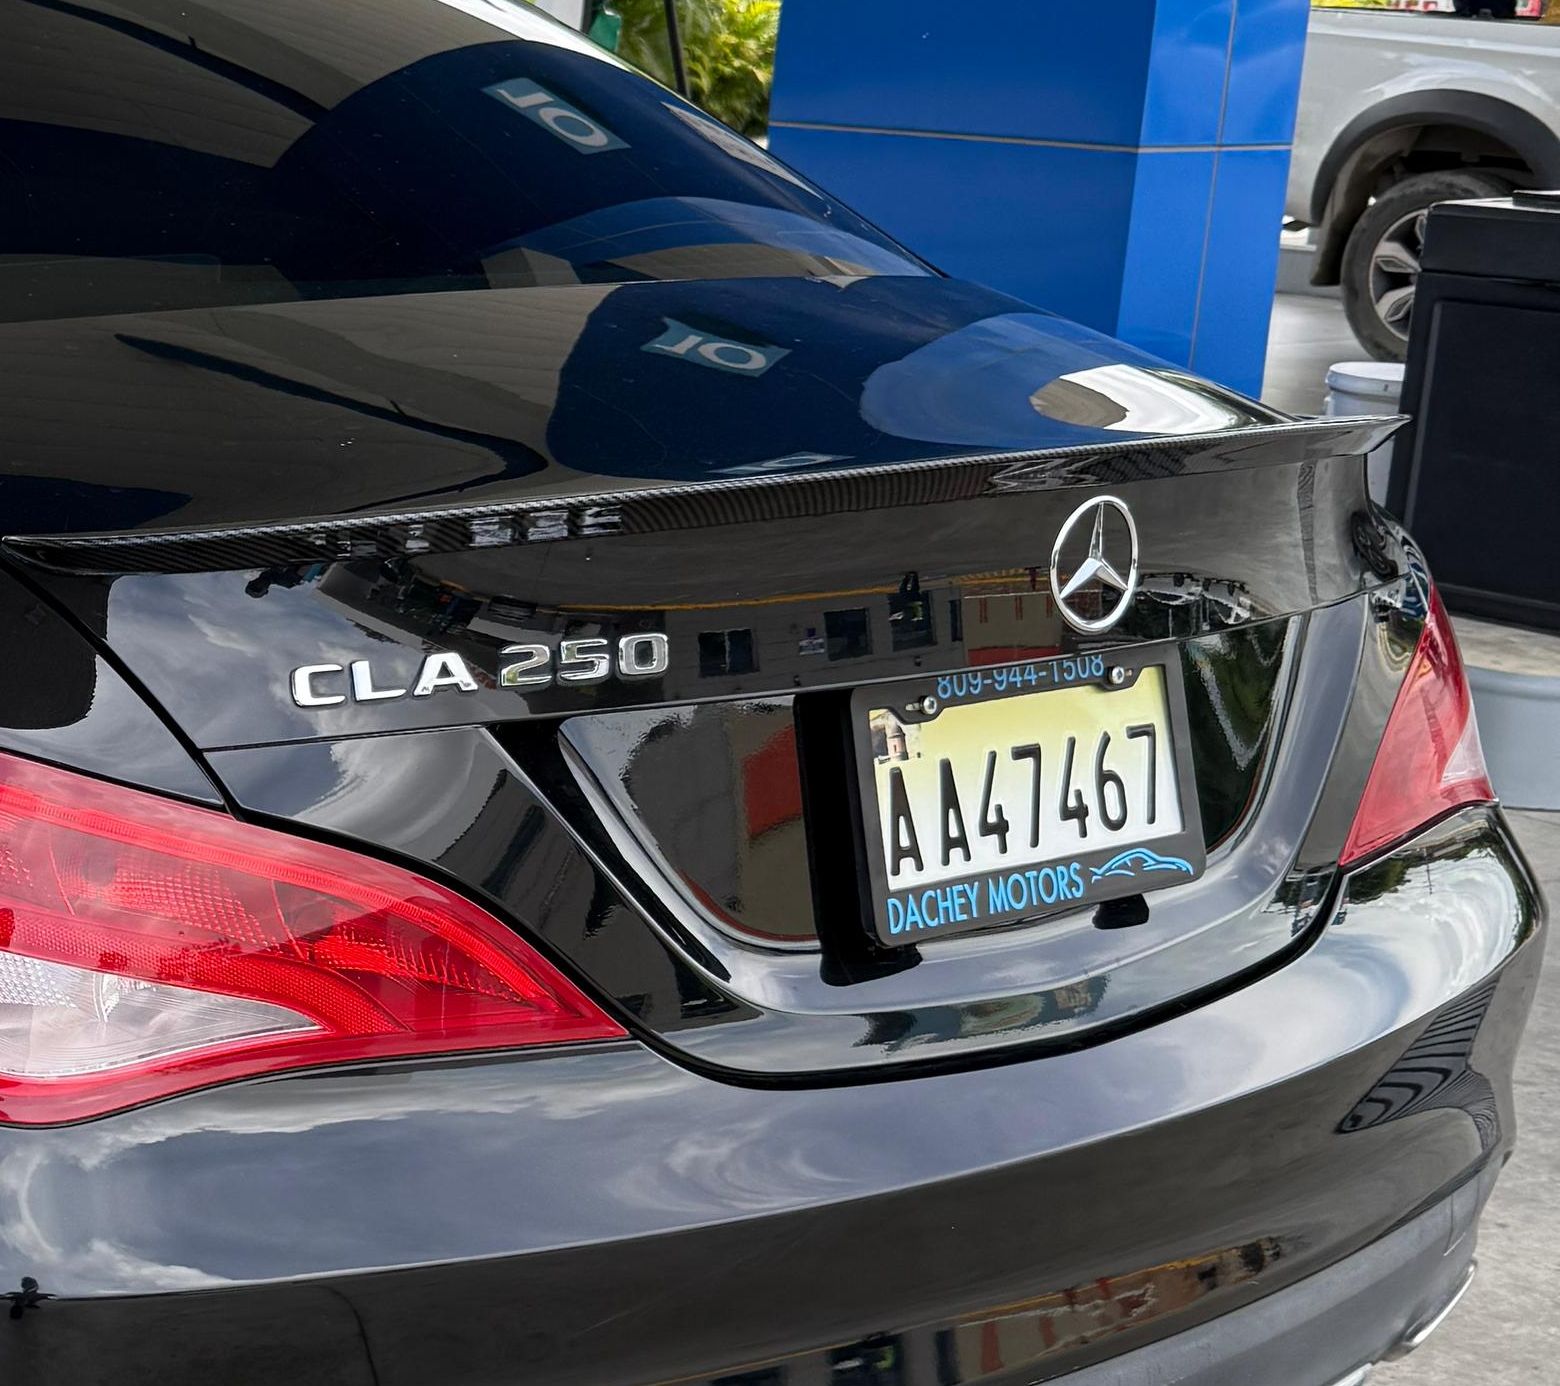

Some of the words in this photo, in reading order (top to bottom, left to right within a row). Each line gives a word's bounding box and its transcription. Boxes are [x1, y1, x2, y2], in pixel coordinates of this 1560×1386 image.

[291, 651, 478, 707] CLA
[499, 633, 669, 686] 250
[936, 654, 1105, 700] 809-944-1508
[889, 723, 1156, 876] AA47467
[887, 880, 979, 934] DACHEY
[989, 862, 1084, 914] MOTORS
